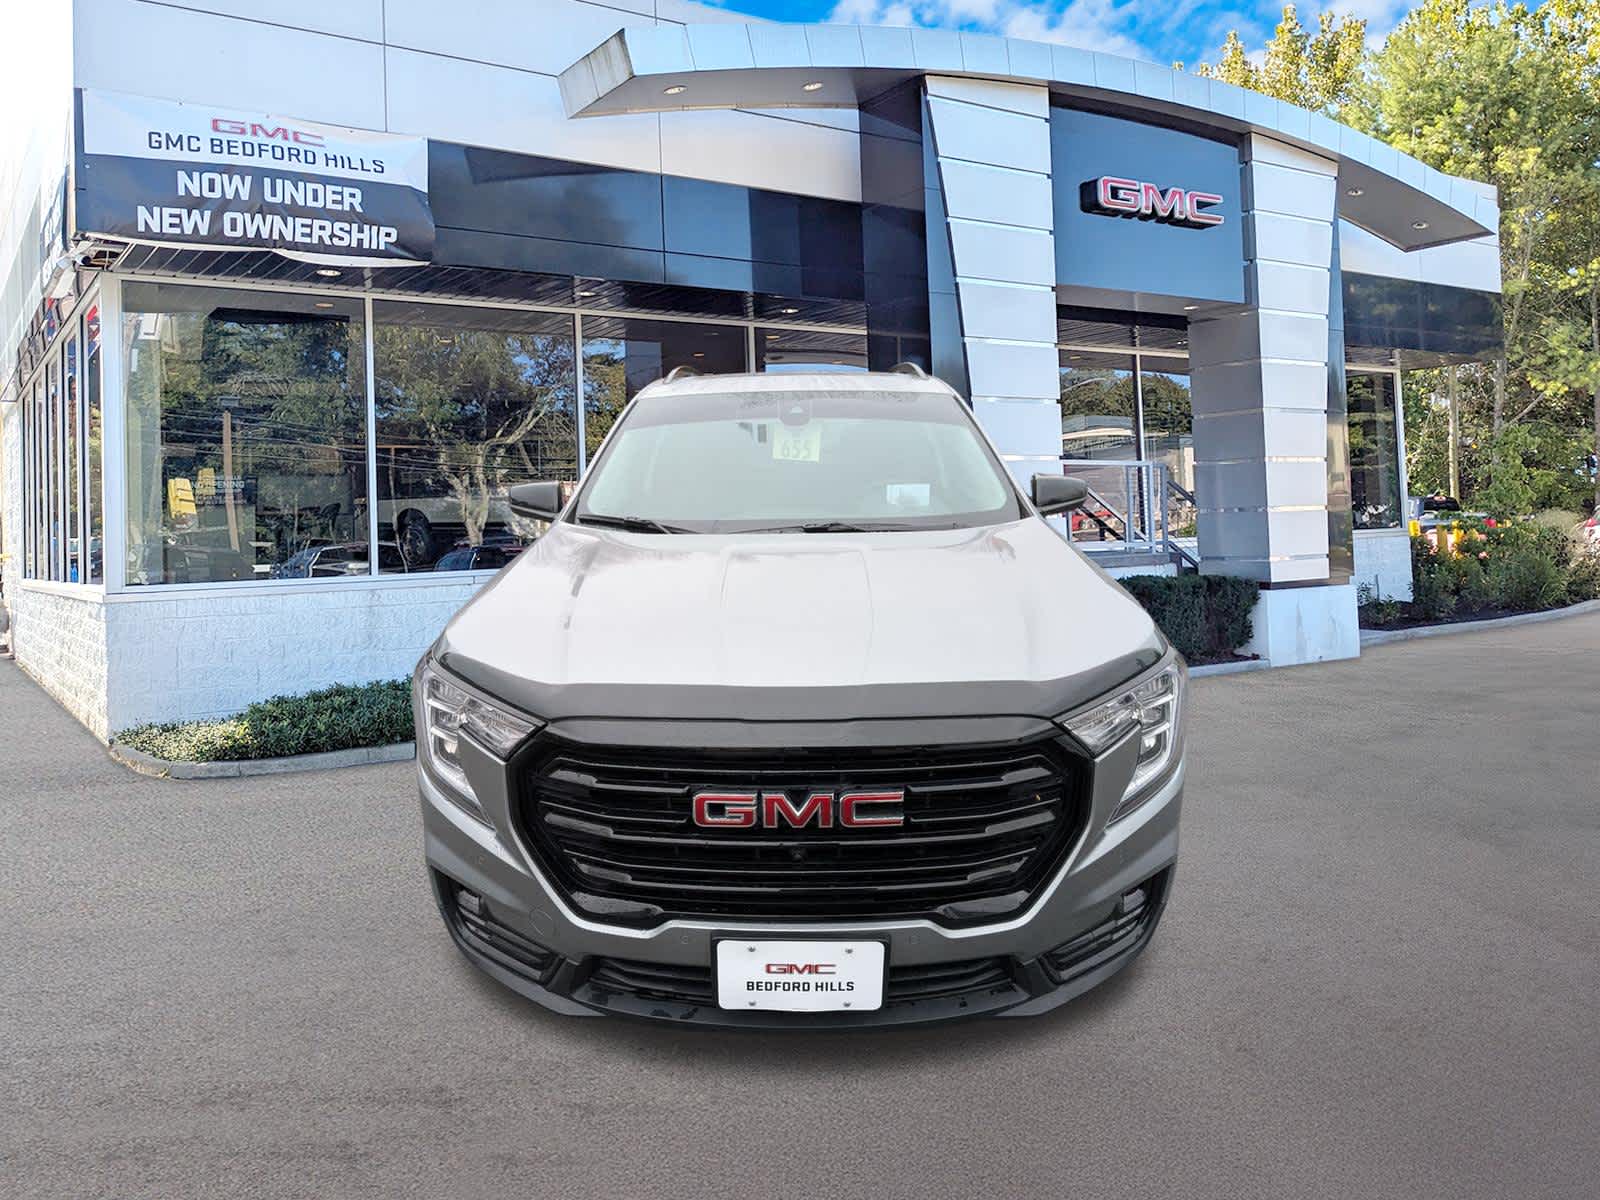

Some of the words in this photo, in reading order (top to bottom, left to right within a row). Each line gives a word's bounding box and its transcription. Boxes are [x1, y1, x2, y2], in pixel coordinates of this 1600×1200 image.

[148, 131, 201, 153] GMC
[210, 138, 317, 166] BEDFORD
[325, 153, 385, 174] HILLS
[211, 117, 325, 148] GMC
[177, 169, 252, 201] NOW
[263, 176, 363, 213] UNDER
[1097, 175, 1225, 225] GMC
[136, 205, 211, 236] NEW
[223, 211, 398, 251] OWNERSHIP
[692, 791, 905, 828] GMC
[746, 981, 811, 992] BEDFORD
[815, 981, 855, 992] HILLS
[765, 963, 836, 975] GMC
